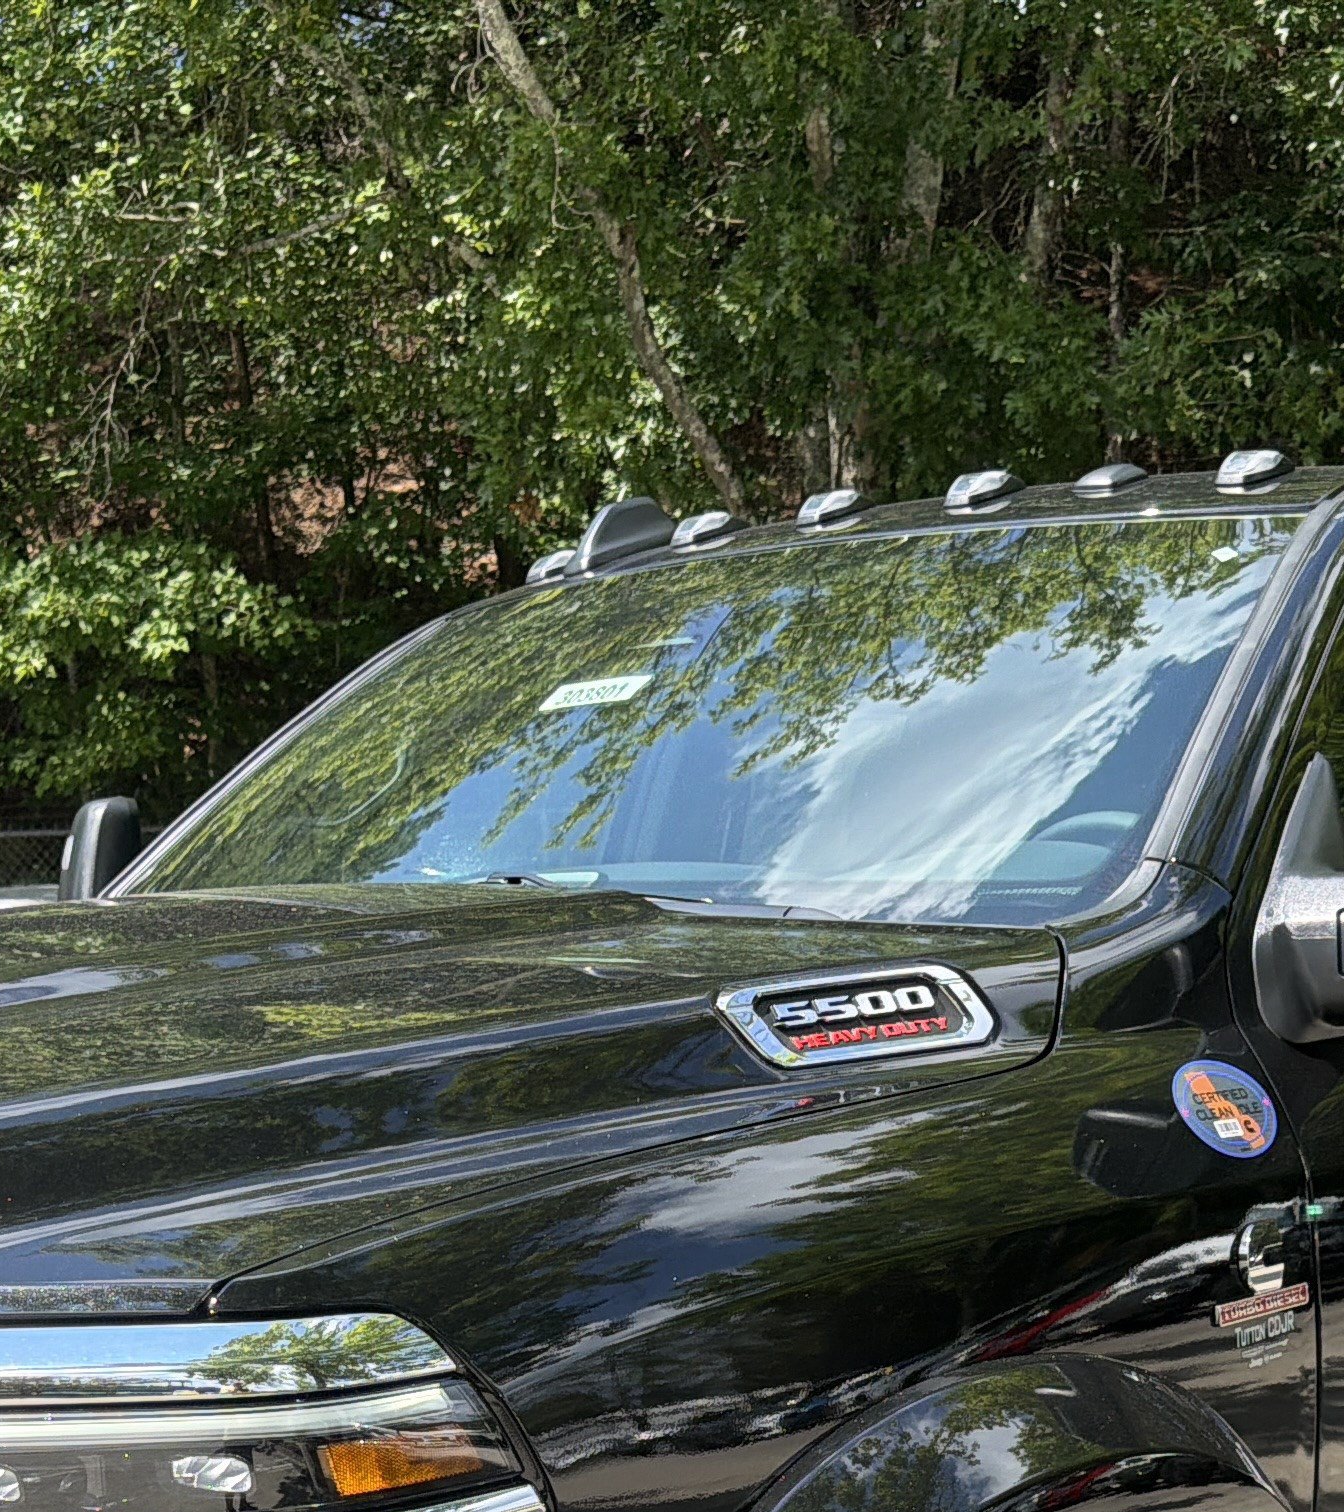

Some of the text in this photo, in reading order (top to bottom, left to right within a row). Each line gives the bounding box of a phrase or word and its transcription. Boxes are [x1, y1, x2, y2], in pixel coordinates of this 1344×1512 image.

[770, 985, 936, 1027] 5500
[791, 1016, 949, 1051] HEAVY DUTY
[1196, 1106, 1235, 1121] CLEAN
[1221, 1286, 1306, 1321] TURBO DIESEL
